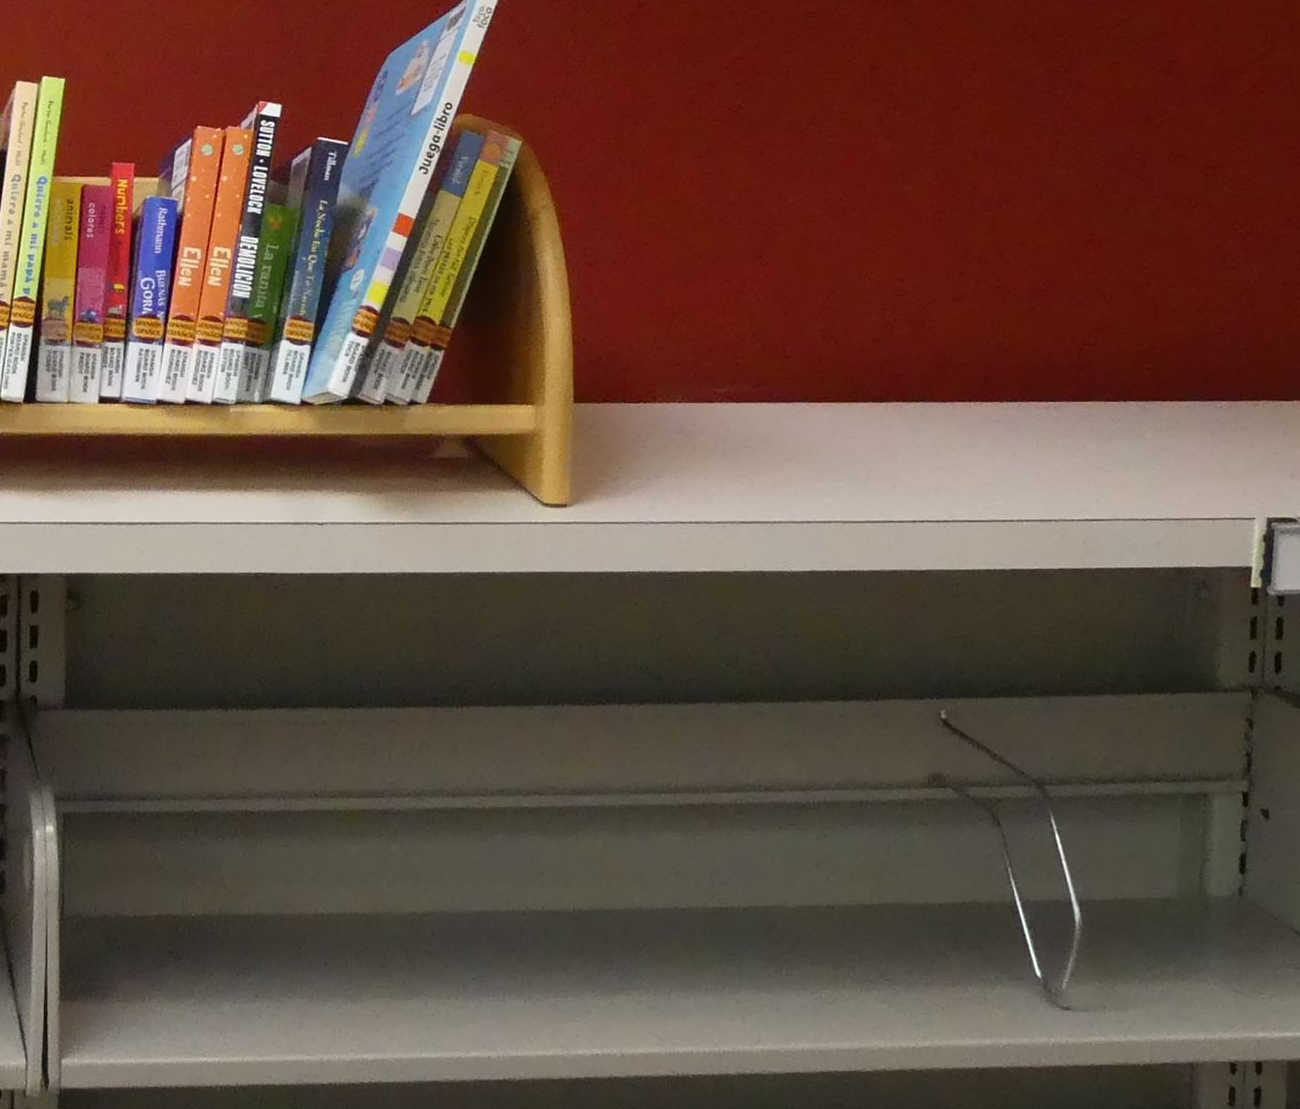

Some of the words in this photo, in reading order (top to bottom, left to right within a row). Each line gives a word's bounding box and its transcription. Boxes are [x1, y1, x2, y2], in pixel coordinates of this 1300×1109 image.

[256, 120, 275, 156] SUTTON
[418, 101, 454, 175] Juega-libro
[324, 151, 337, 181] Tillman
[8, 174, 22, 215] Quiero
[32, 176, 48, 218] Quiero
[115, 179, 128, 235] Numbers
[247, 166, 268, 214] LOVELOCK
[63, 198, 74, 241] animals
[86, 203, 96, 238] colores
[154, 207, 168, 254] Rathmann
[0, 251, 12, 288] mamá
[23, 253, 36, 283] papá
[232, 236, 258, 299] DEMOLICIÓN
